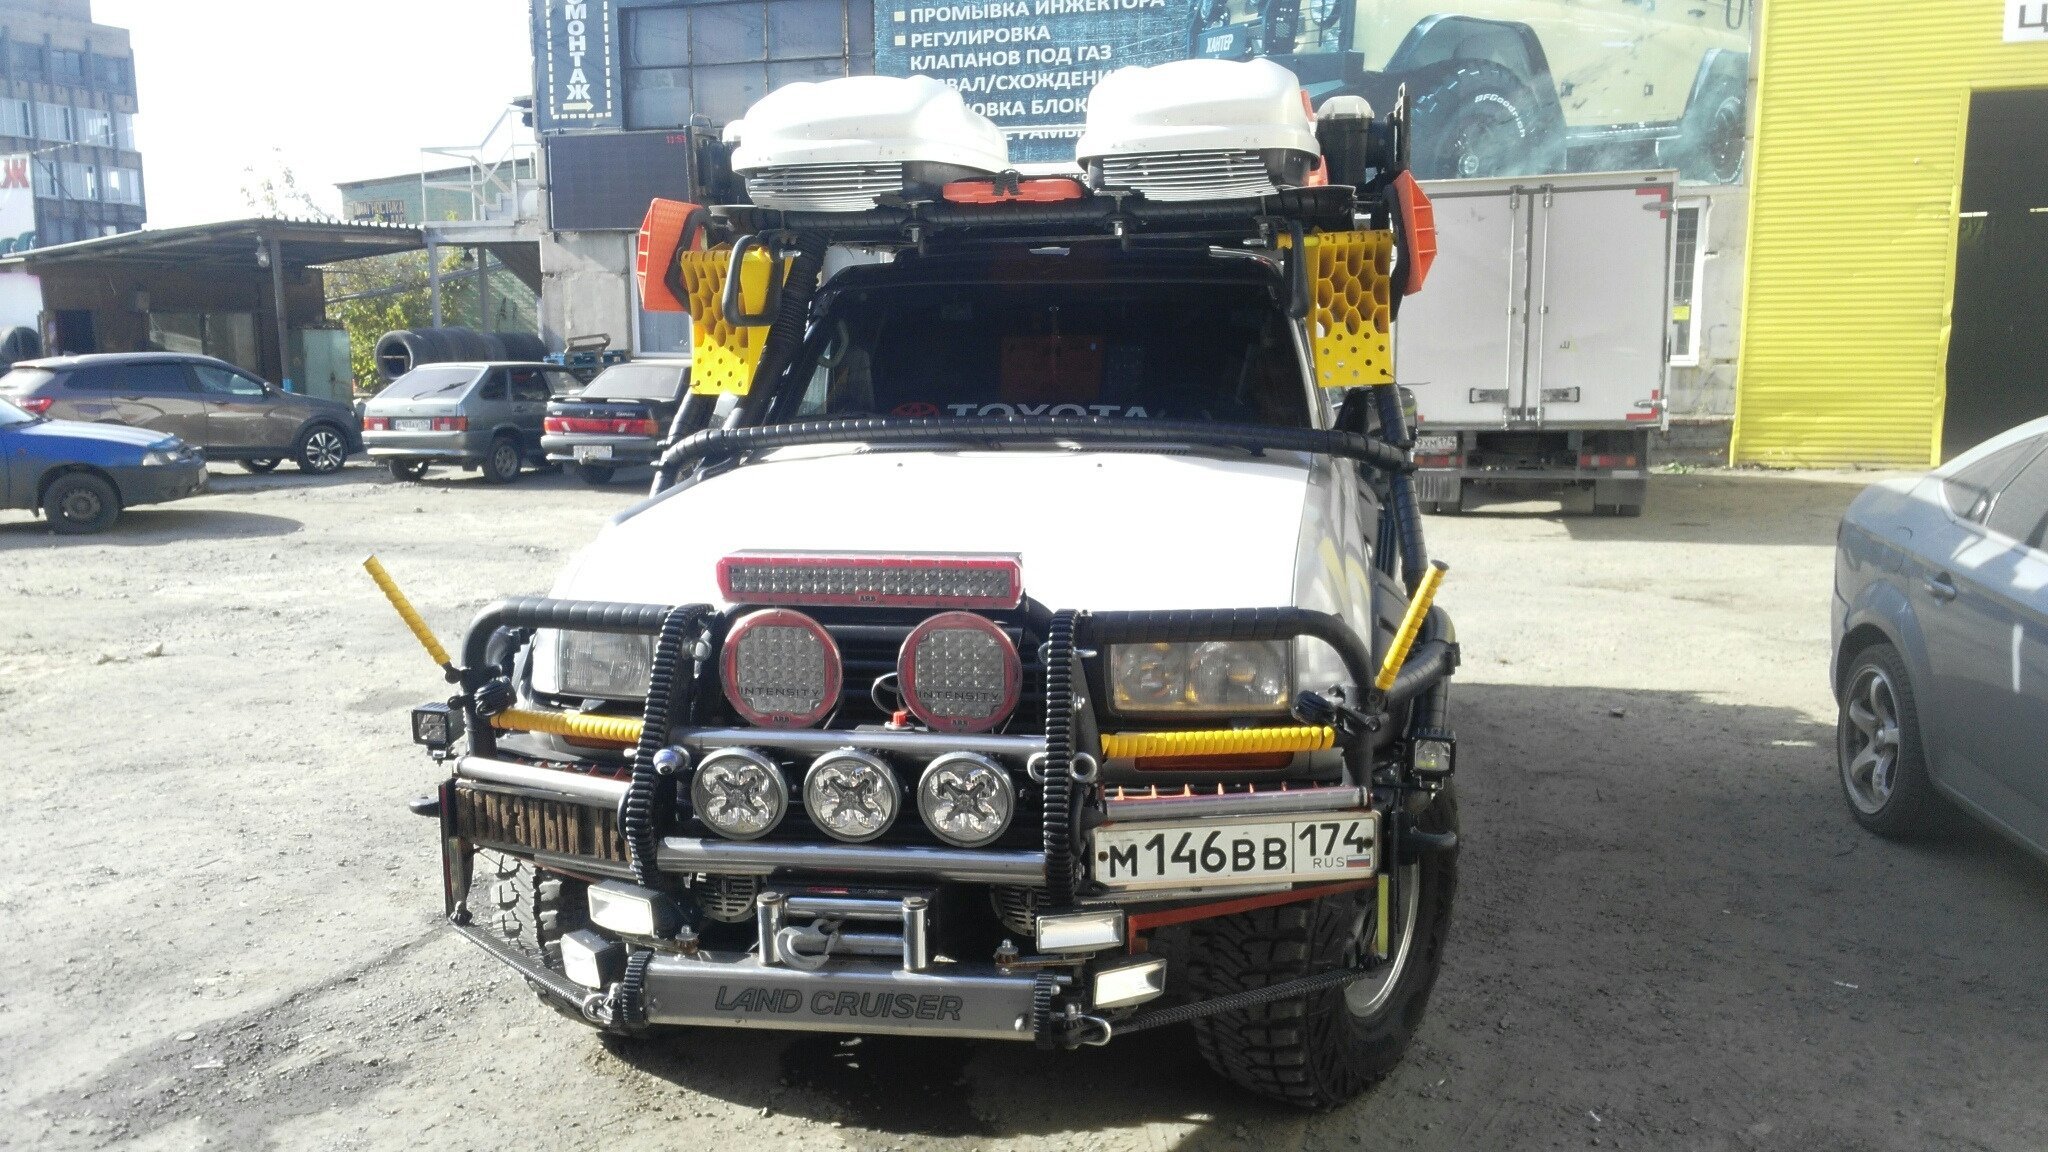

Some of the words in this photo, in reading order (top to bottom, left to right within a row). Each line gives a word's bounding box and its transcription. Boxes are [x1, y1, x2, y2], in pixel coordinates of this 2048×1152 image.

[910, 2, 1030, 23] ПРОМЫВКА
[910, 25, 1051, 48] РЕГУЛИРОВКА
[565, 0, 591, 100] МОНТАЖ
[910, 50, 1021, 71] КЛАПАНОВ
[1026, 48, 1072, 66] ПОД
[1077, 44, 1112, 61] ГАЗ
[1031, 97, 1088, 115] БЛОК
[1474, 93, 1526, 138] BFGoodrich
[858, 594, 878, 603] ARB
[740, 686, 821, 698] INTENSITY
[918, 690, 1000, 702] INTENSITY
[1109, 830, 1288, 878] М146ВВ
[1299, 822, 1365, 856] 174
[1312, 857, 1345, 869] RUS
[714, 985, 803, 1014] LAND
[810, 990, 964, 1021] CRUISER
